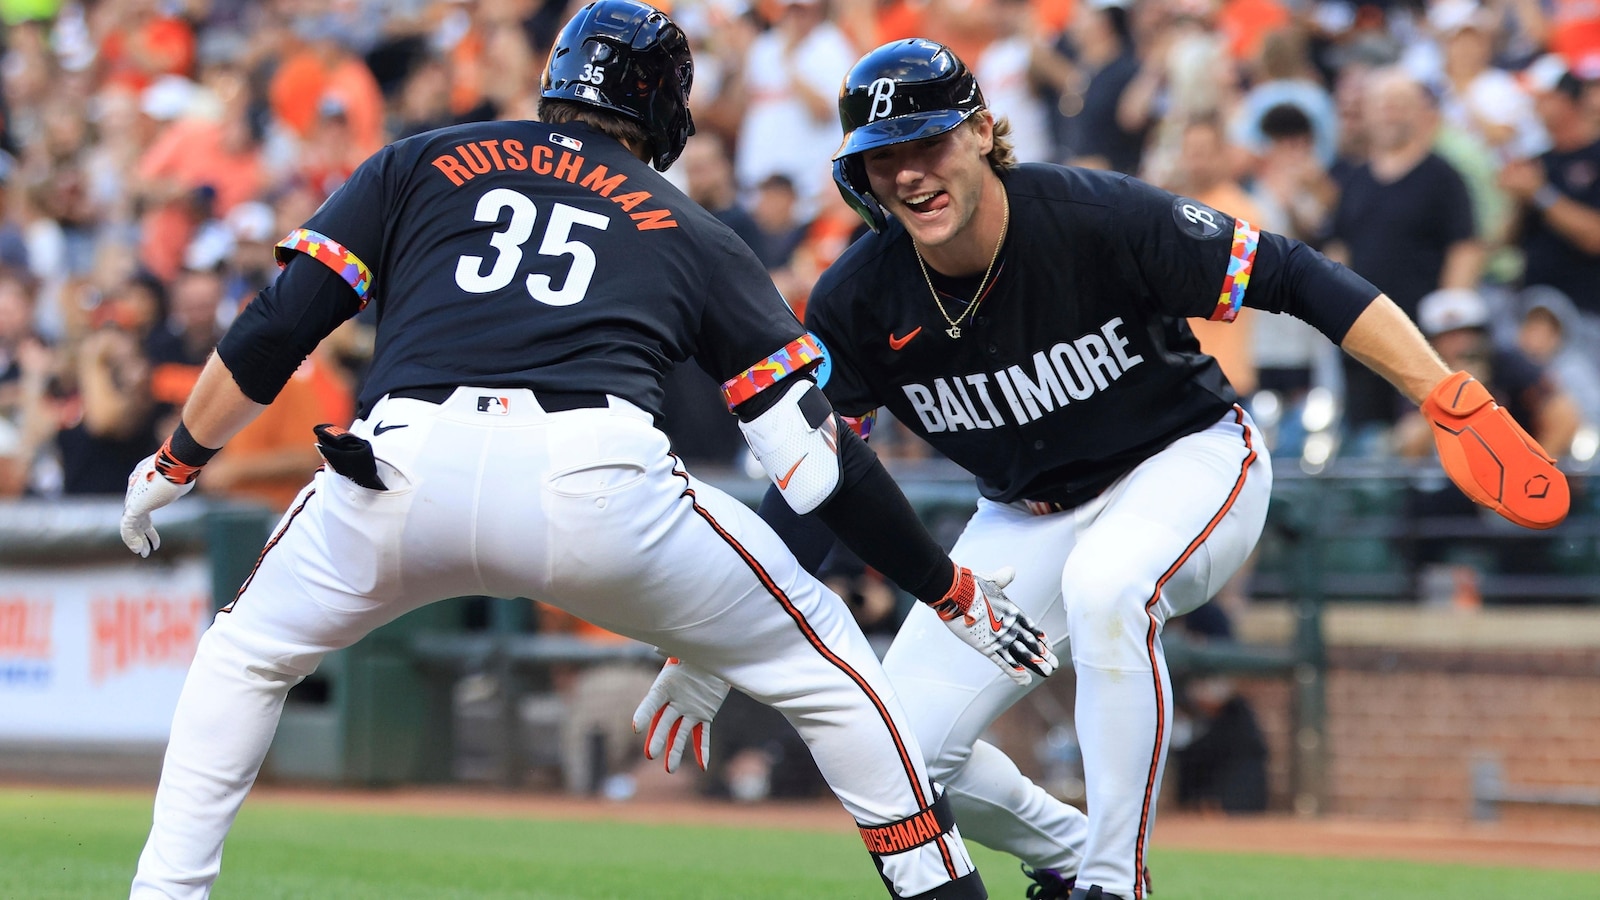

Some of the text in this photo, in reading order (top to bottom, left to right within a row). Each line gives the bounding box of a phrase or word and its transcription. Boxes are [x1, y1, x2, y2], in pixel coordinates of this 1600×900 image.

[579, 63, 604, 85] 35
[868, 77, 895, 122] B
[432, 139, 678, 231] RUTSCHMAN
[1183, 204, 1218, 229] B
[455, 188, 610, 306] 35
[902, 317, 1144, 433] BALTIMORE
